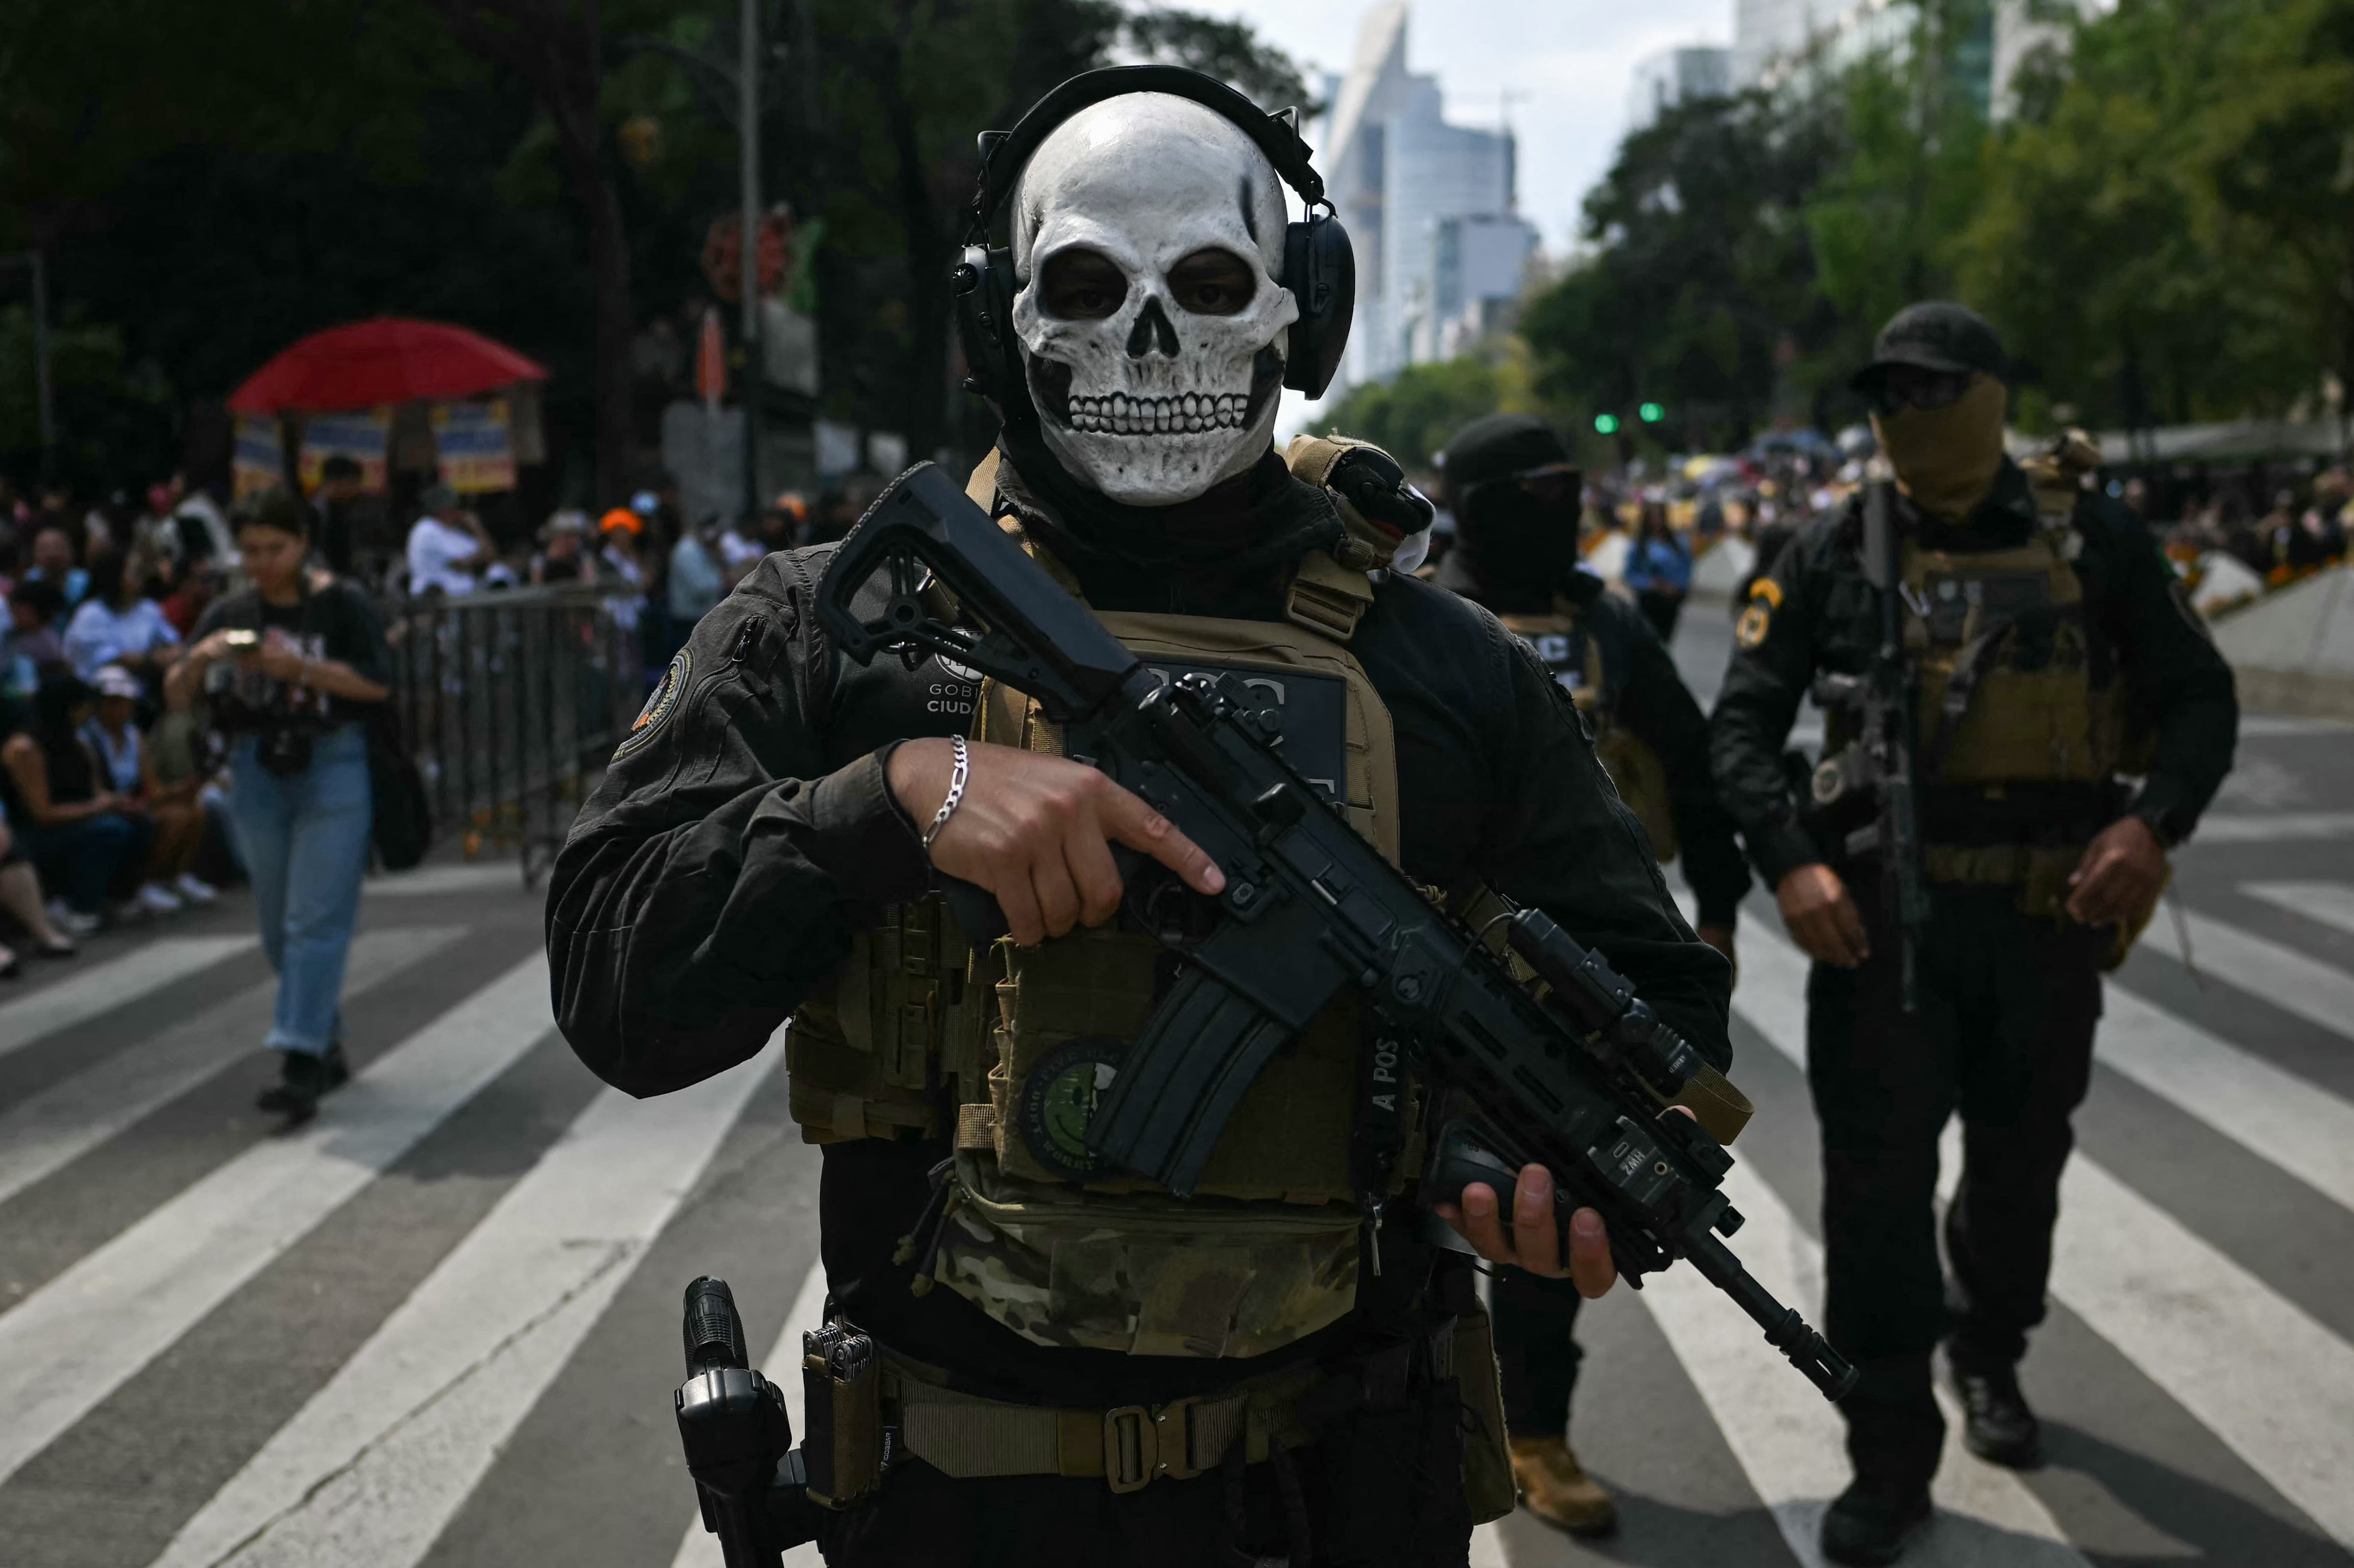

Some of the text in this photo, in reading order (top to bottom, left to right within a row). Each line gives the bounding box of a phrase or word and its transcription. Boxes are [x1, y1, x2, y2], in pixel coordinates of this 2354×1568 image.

[929, 684, 978, 699] GOBI
[927, 700, 976, 715] CIUD
[1372, 1038, 1399, 1112] A POS
[883, 1432, 892, 1461] IDOGEAR
